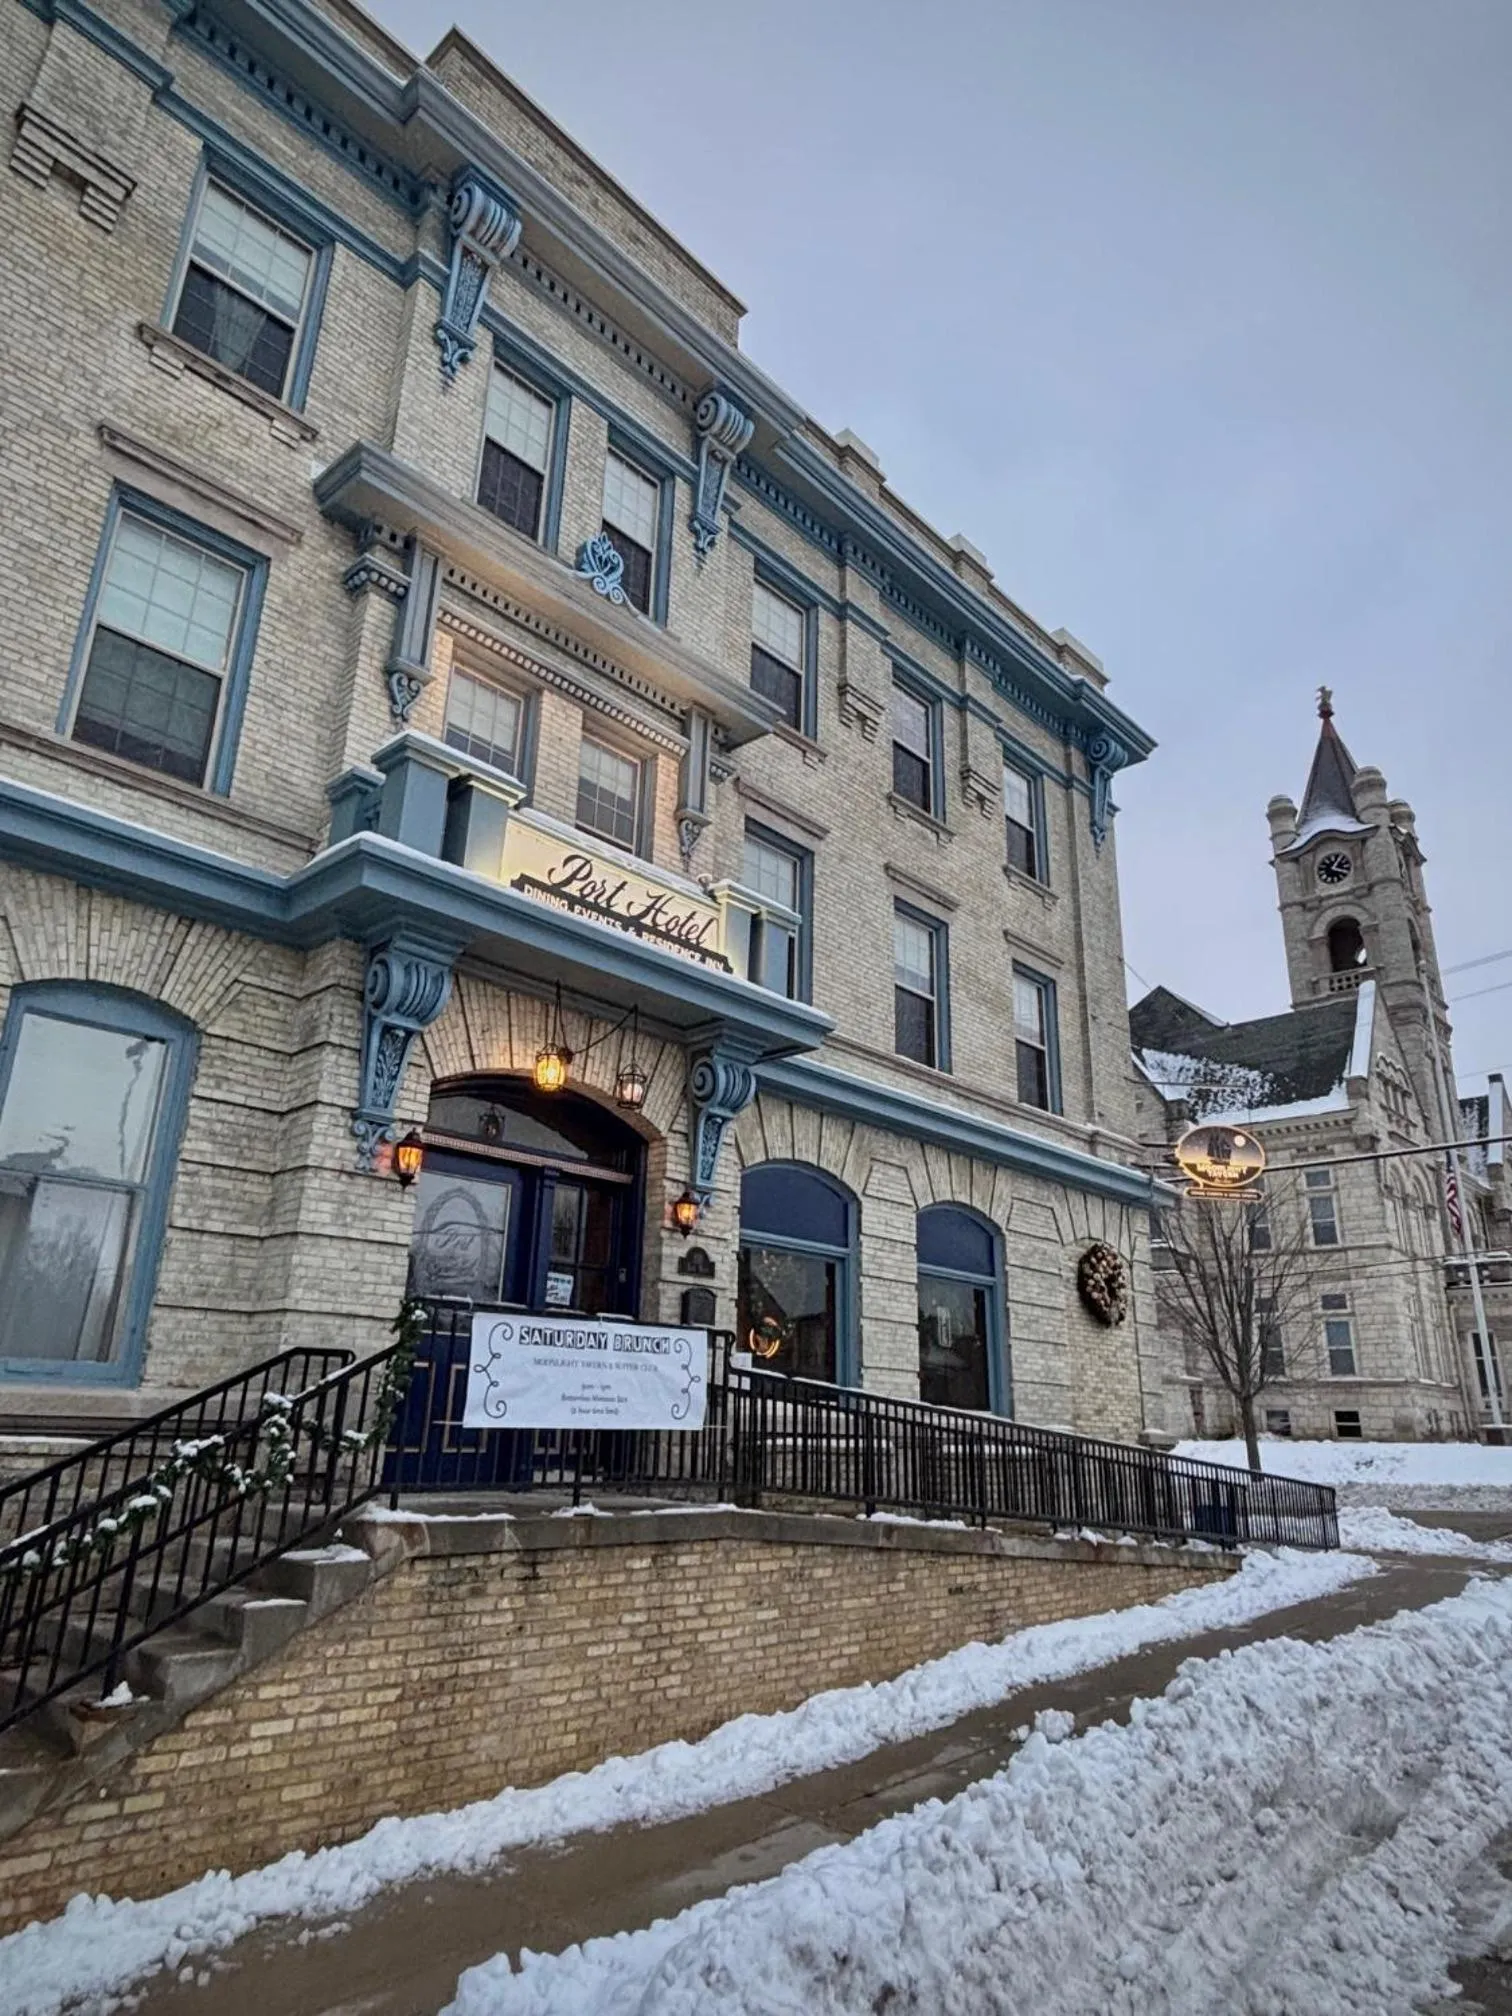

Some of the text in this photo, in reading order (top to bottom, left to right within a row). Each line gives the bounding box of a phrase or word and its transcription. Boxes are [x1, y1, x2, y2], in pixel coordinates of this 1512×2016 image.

[548, 854, 717, 946] Port Hotel
[573, 904, 622, 930] EVENTS
[642, 932, 702, 962] RESIDENCE
[519, 1325, 671, 1354] SATURDAY BRUNCH
